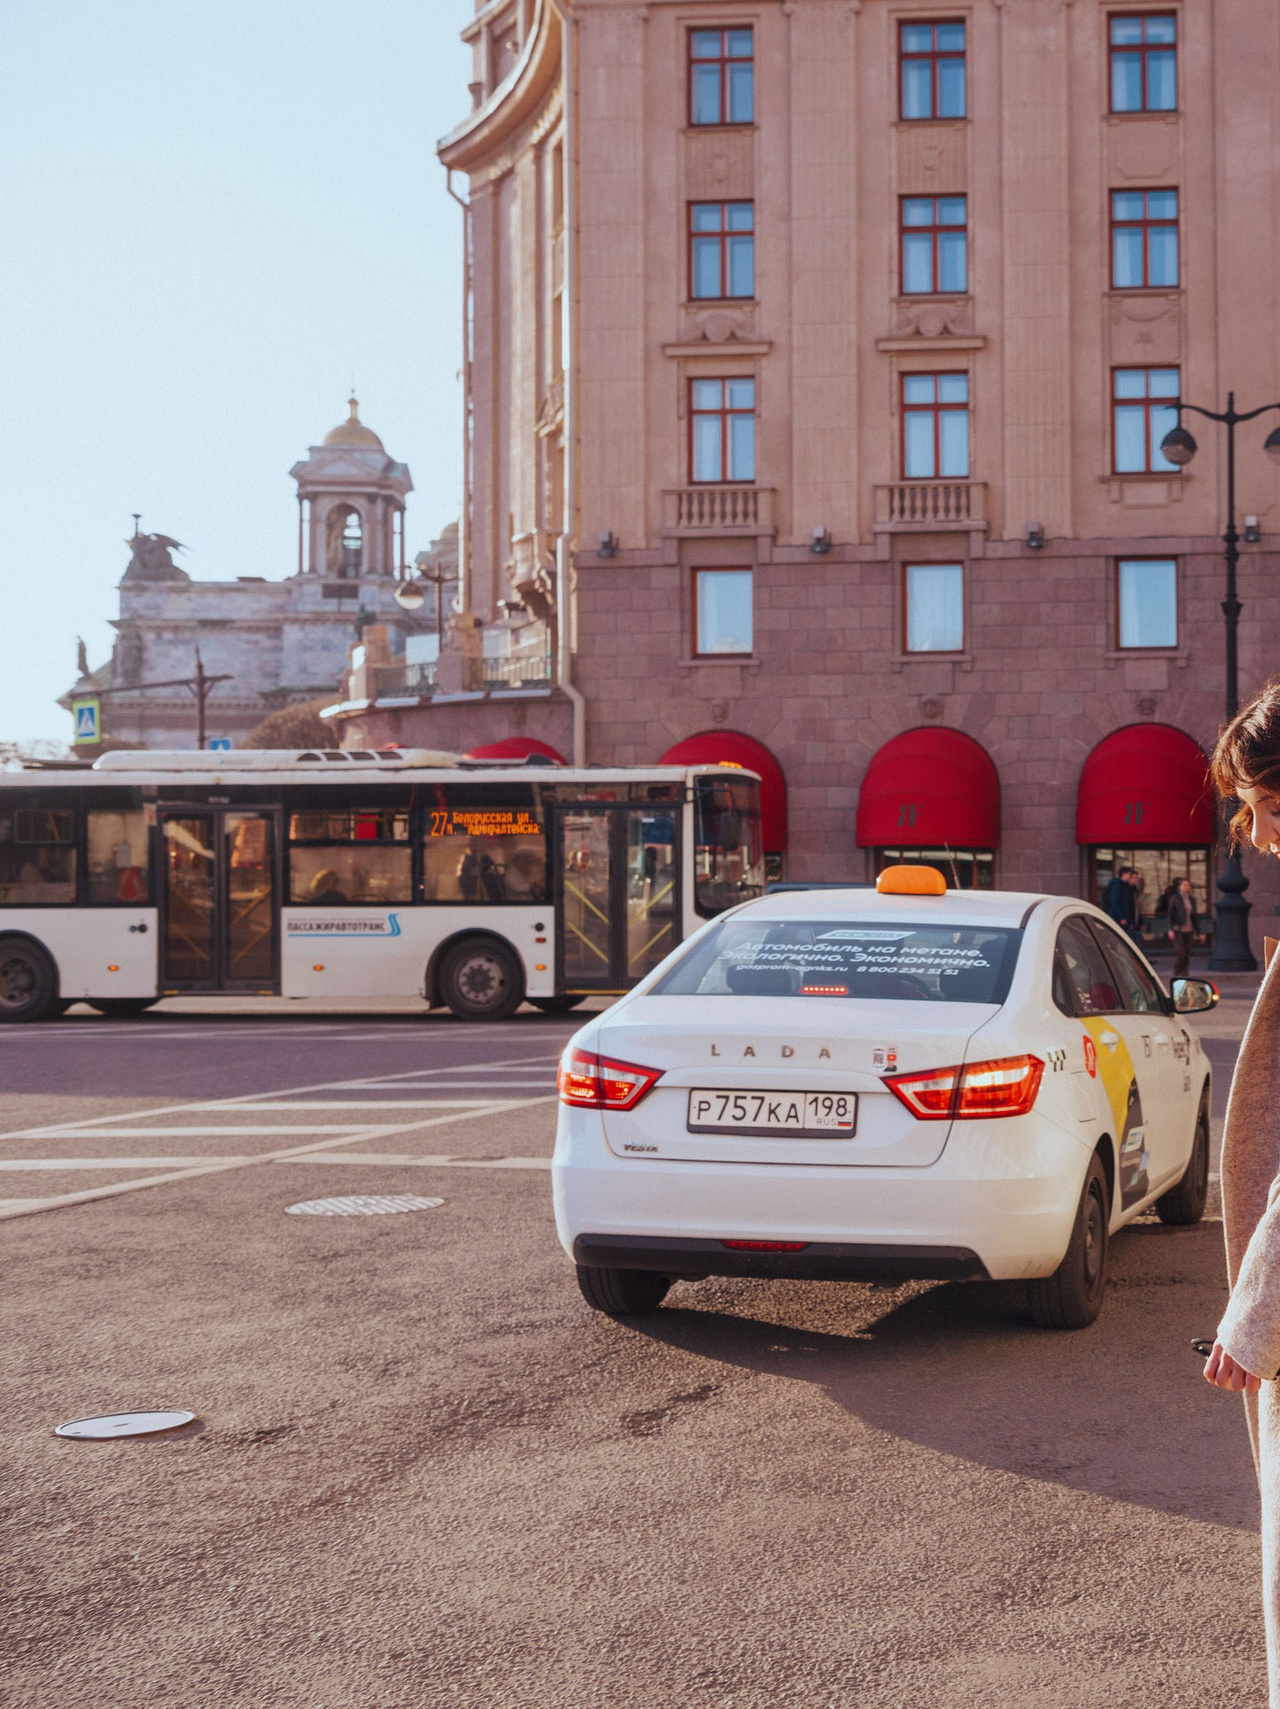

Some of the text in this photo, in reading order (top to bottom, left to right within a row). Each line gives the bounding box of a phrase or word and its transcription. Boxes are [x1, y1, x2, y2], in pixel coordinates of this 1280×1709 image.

[430, 811, 449, 837] 27
[736, 941, 984, 958] Автомобиль на метане.
[718, 951, 991, 968] Экологично. Экономично.
[867, 966, 898, 974] 800
[710, 1044, 832, 1059] LADA
[809, 1096, 848, 1117] 198
[817, 1118, 837, 1127] RUS
